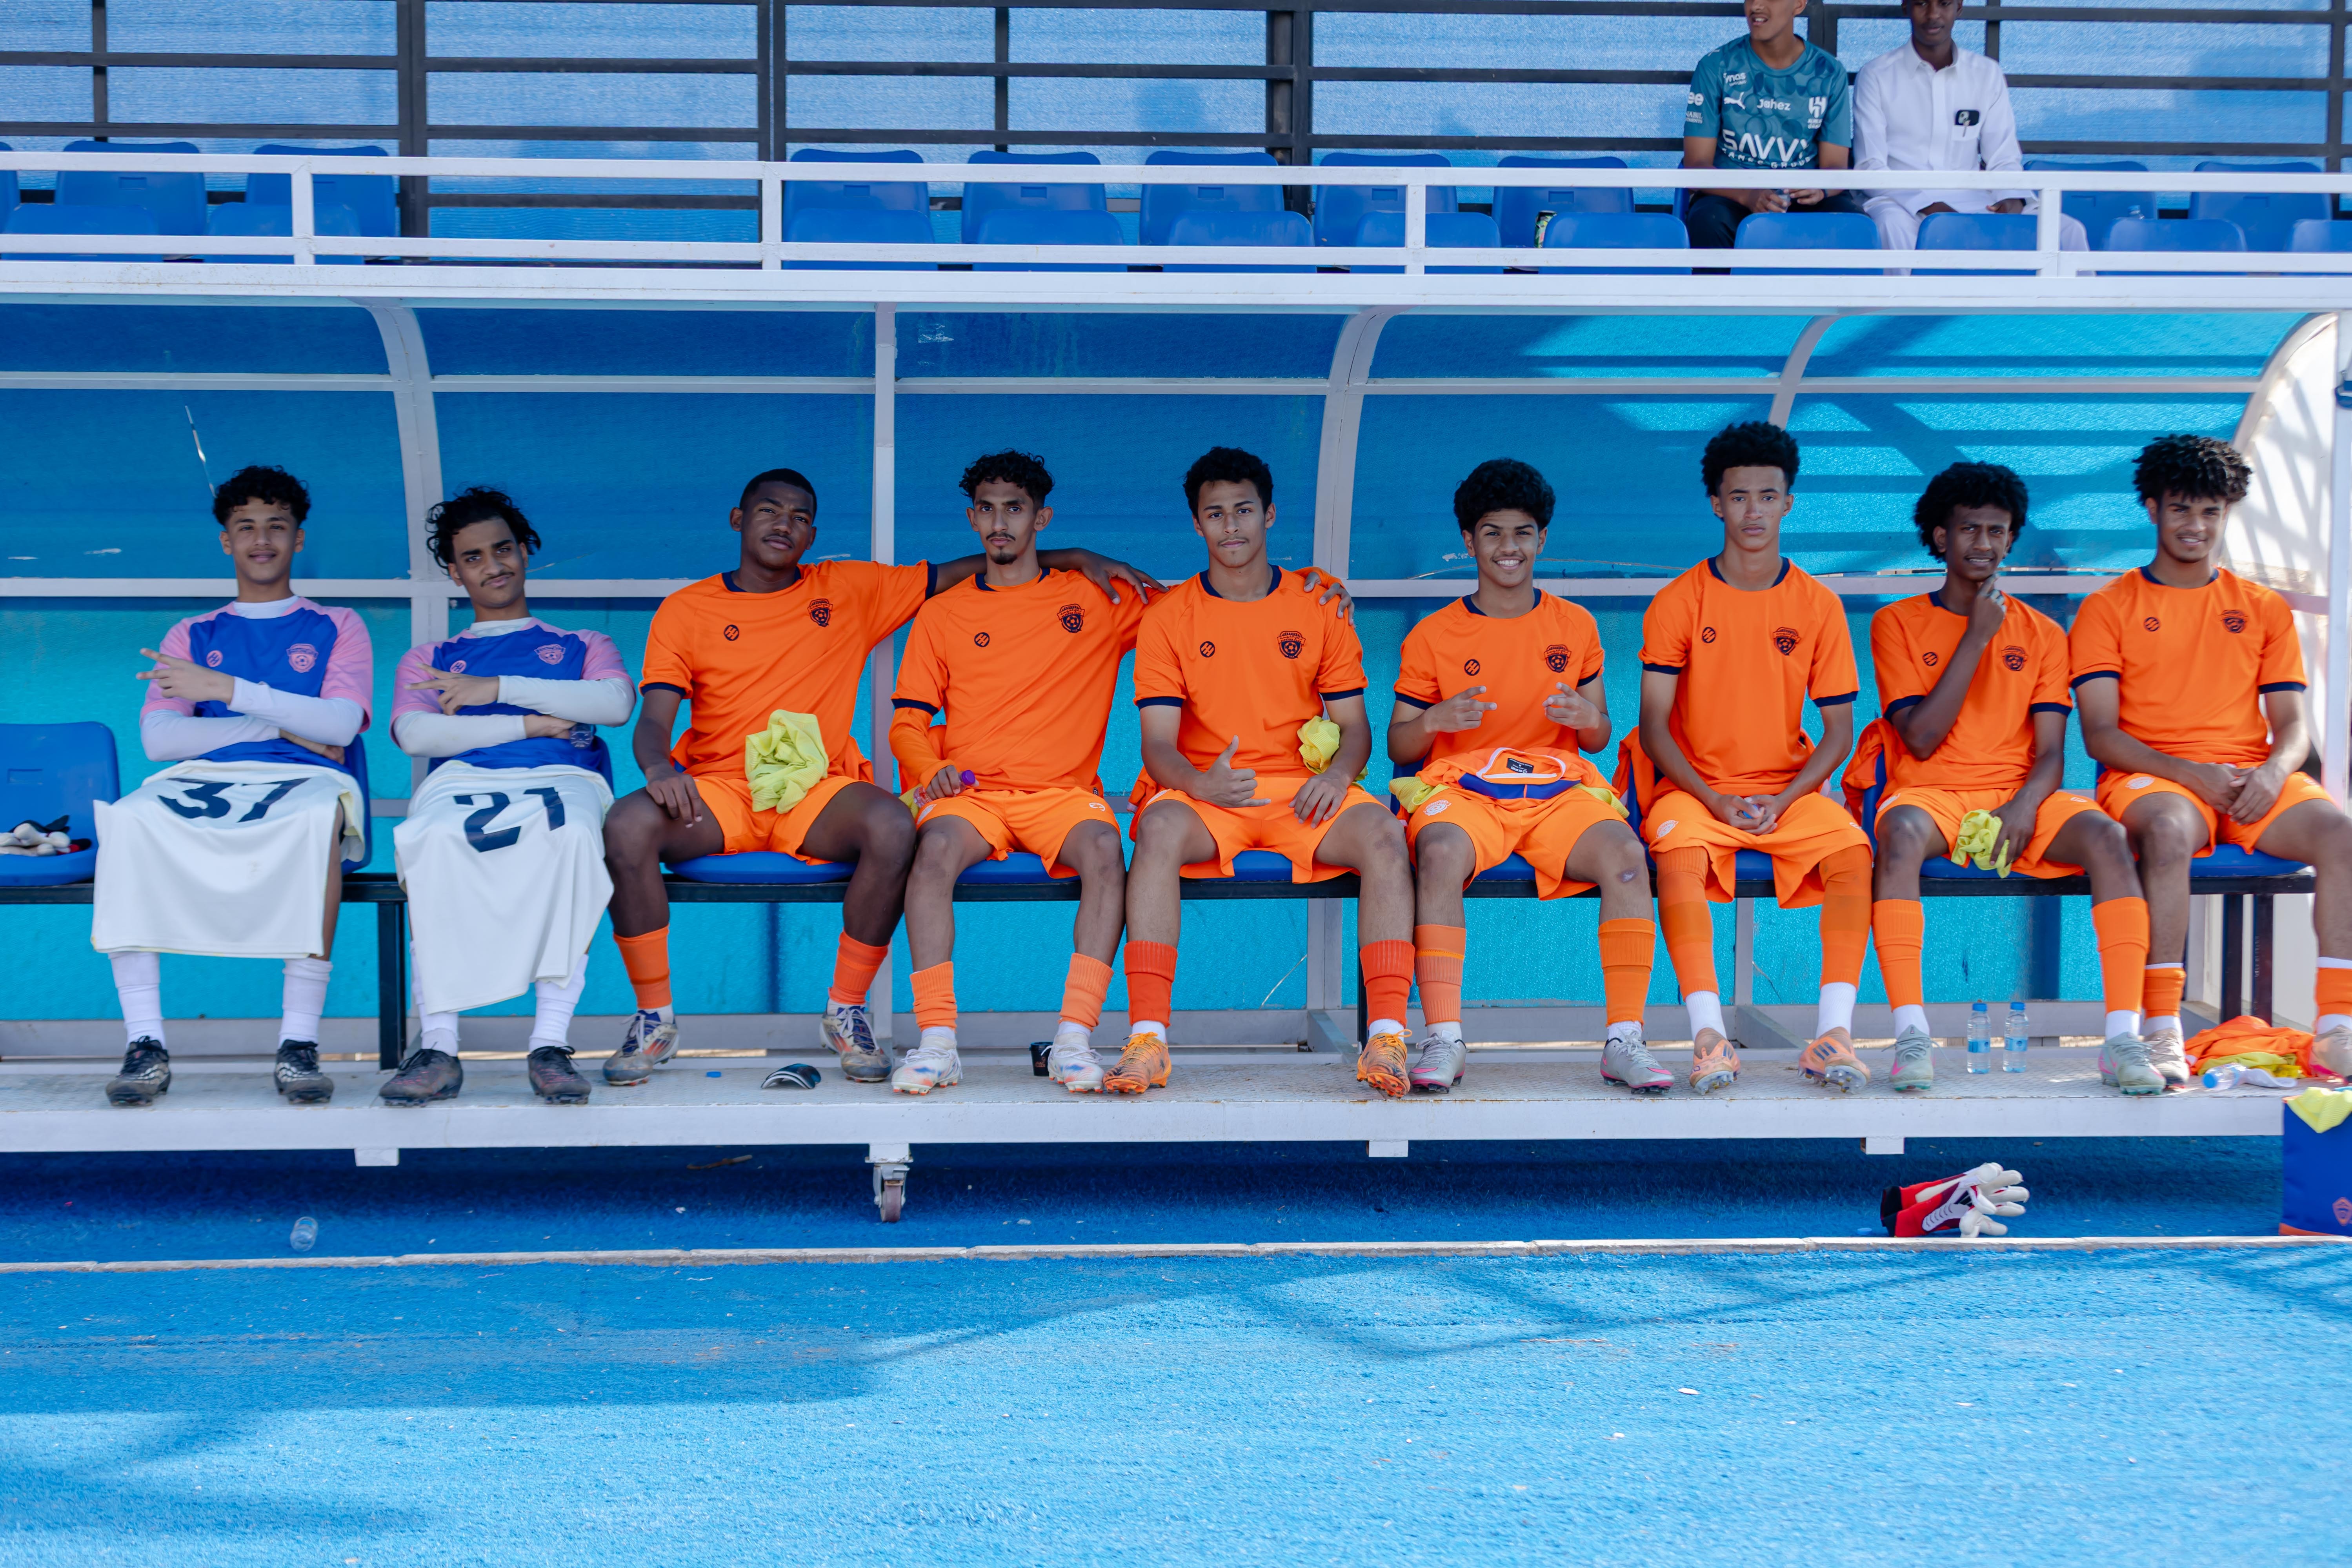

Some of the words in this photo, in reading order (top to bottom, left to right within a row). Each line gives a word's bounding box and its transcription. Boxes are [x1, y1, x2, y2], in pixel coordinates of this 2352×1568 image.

[1757, 99, 1791, 111] Jahez
[158, 778, 311, 822] 37
[454, 787, 565, 852] 21
